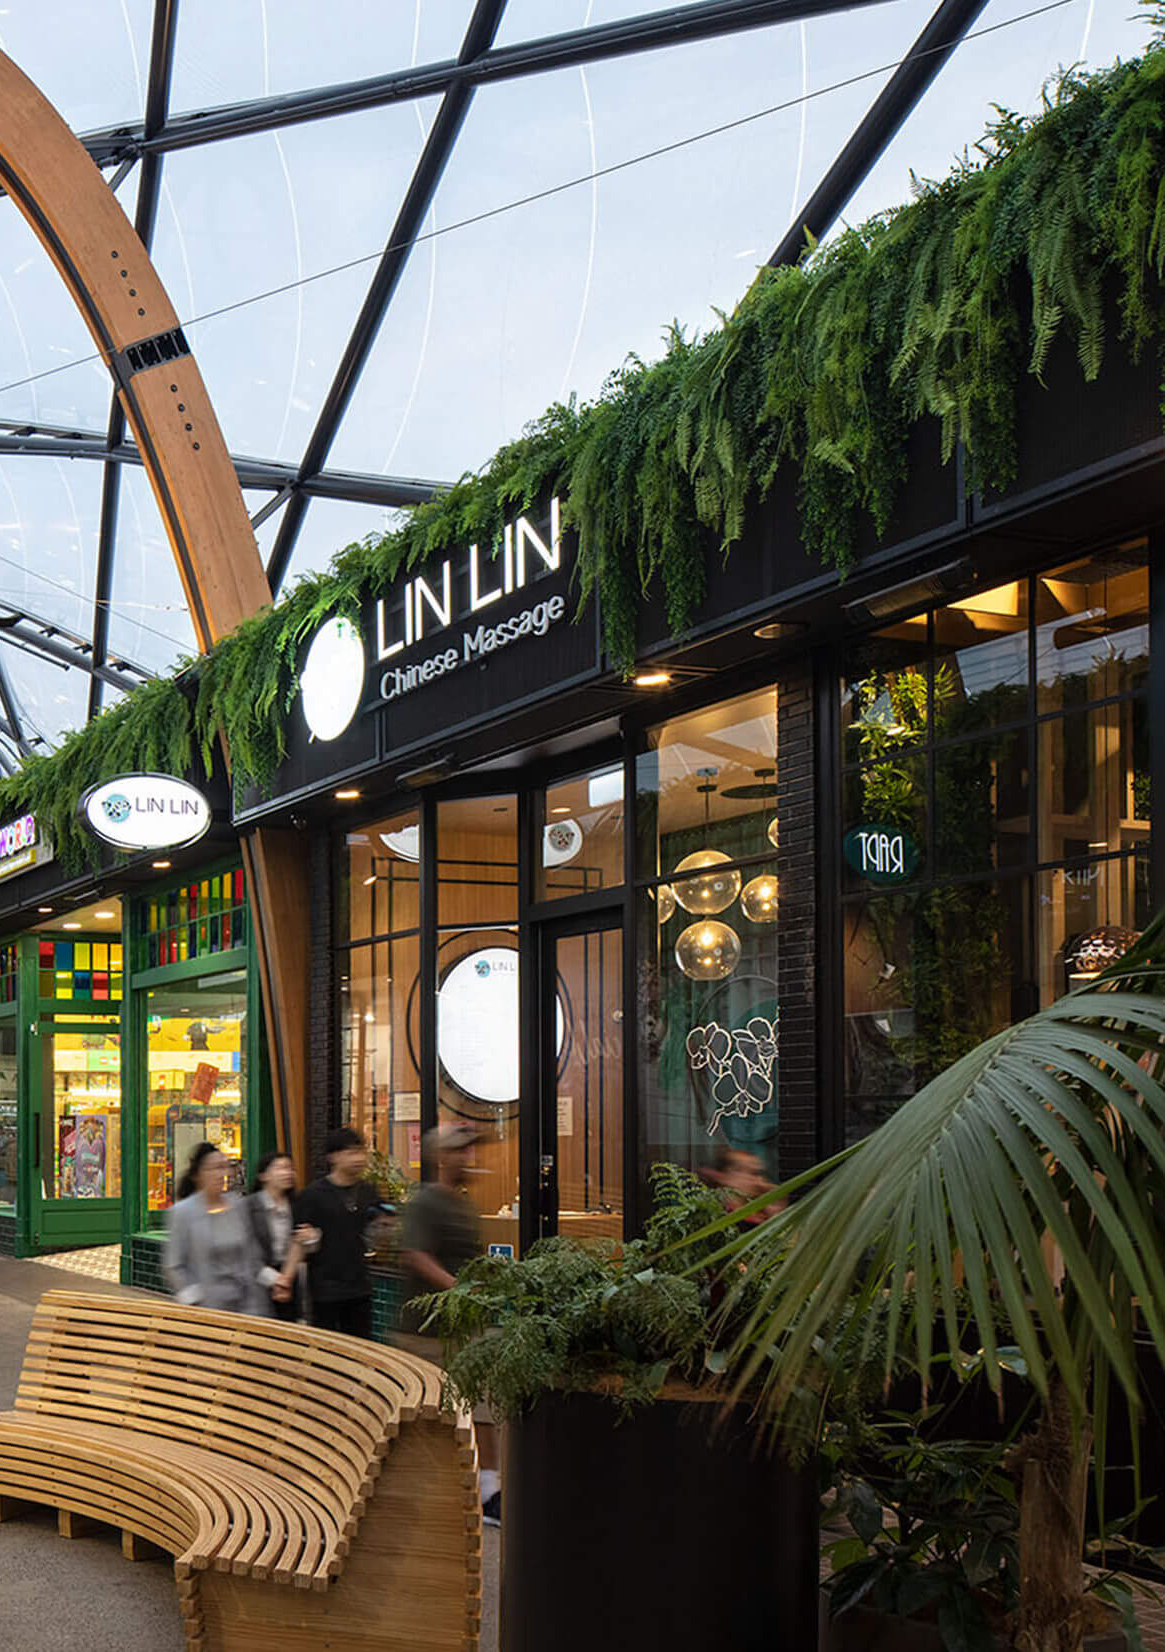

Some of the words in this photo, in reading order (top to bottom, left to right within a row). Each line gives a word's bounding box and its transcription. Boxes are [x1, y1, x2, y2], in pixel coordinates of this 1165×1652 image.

[377, 559, 452, 662] LIN
[469, 496, 561, 612] LIN
[380, 648, 459, 700] Chinese
[463, 595, 565, 662] Massage
[136, 796, 164, 813] LIN
[170, 798, 198, 815] LIN
